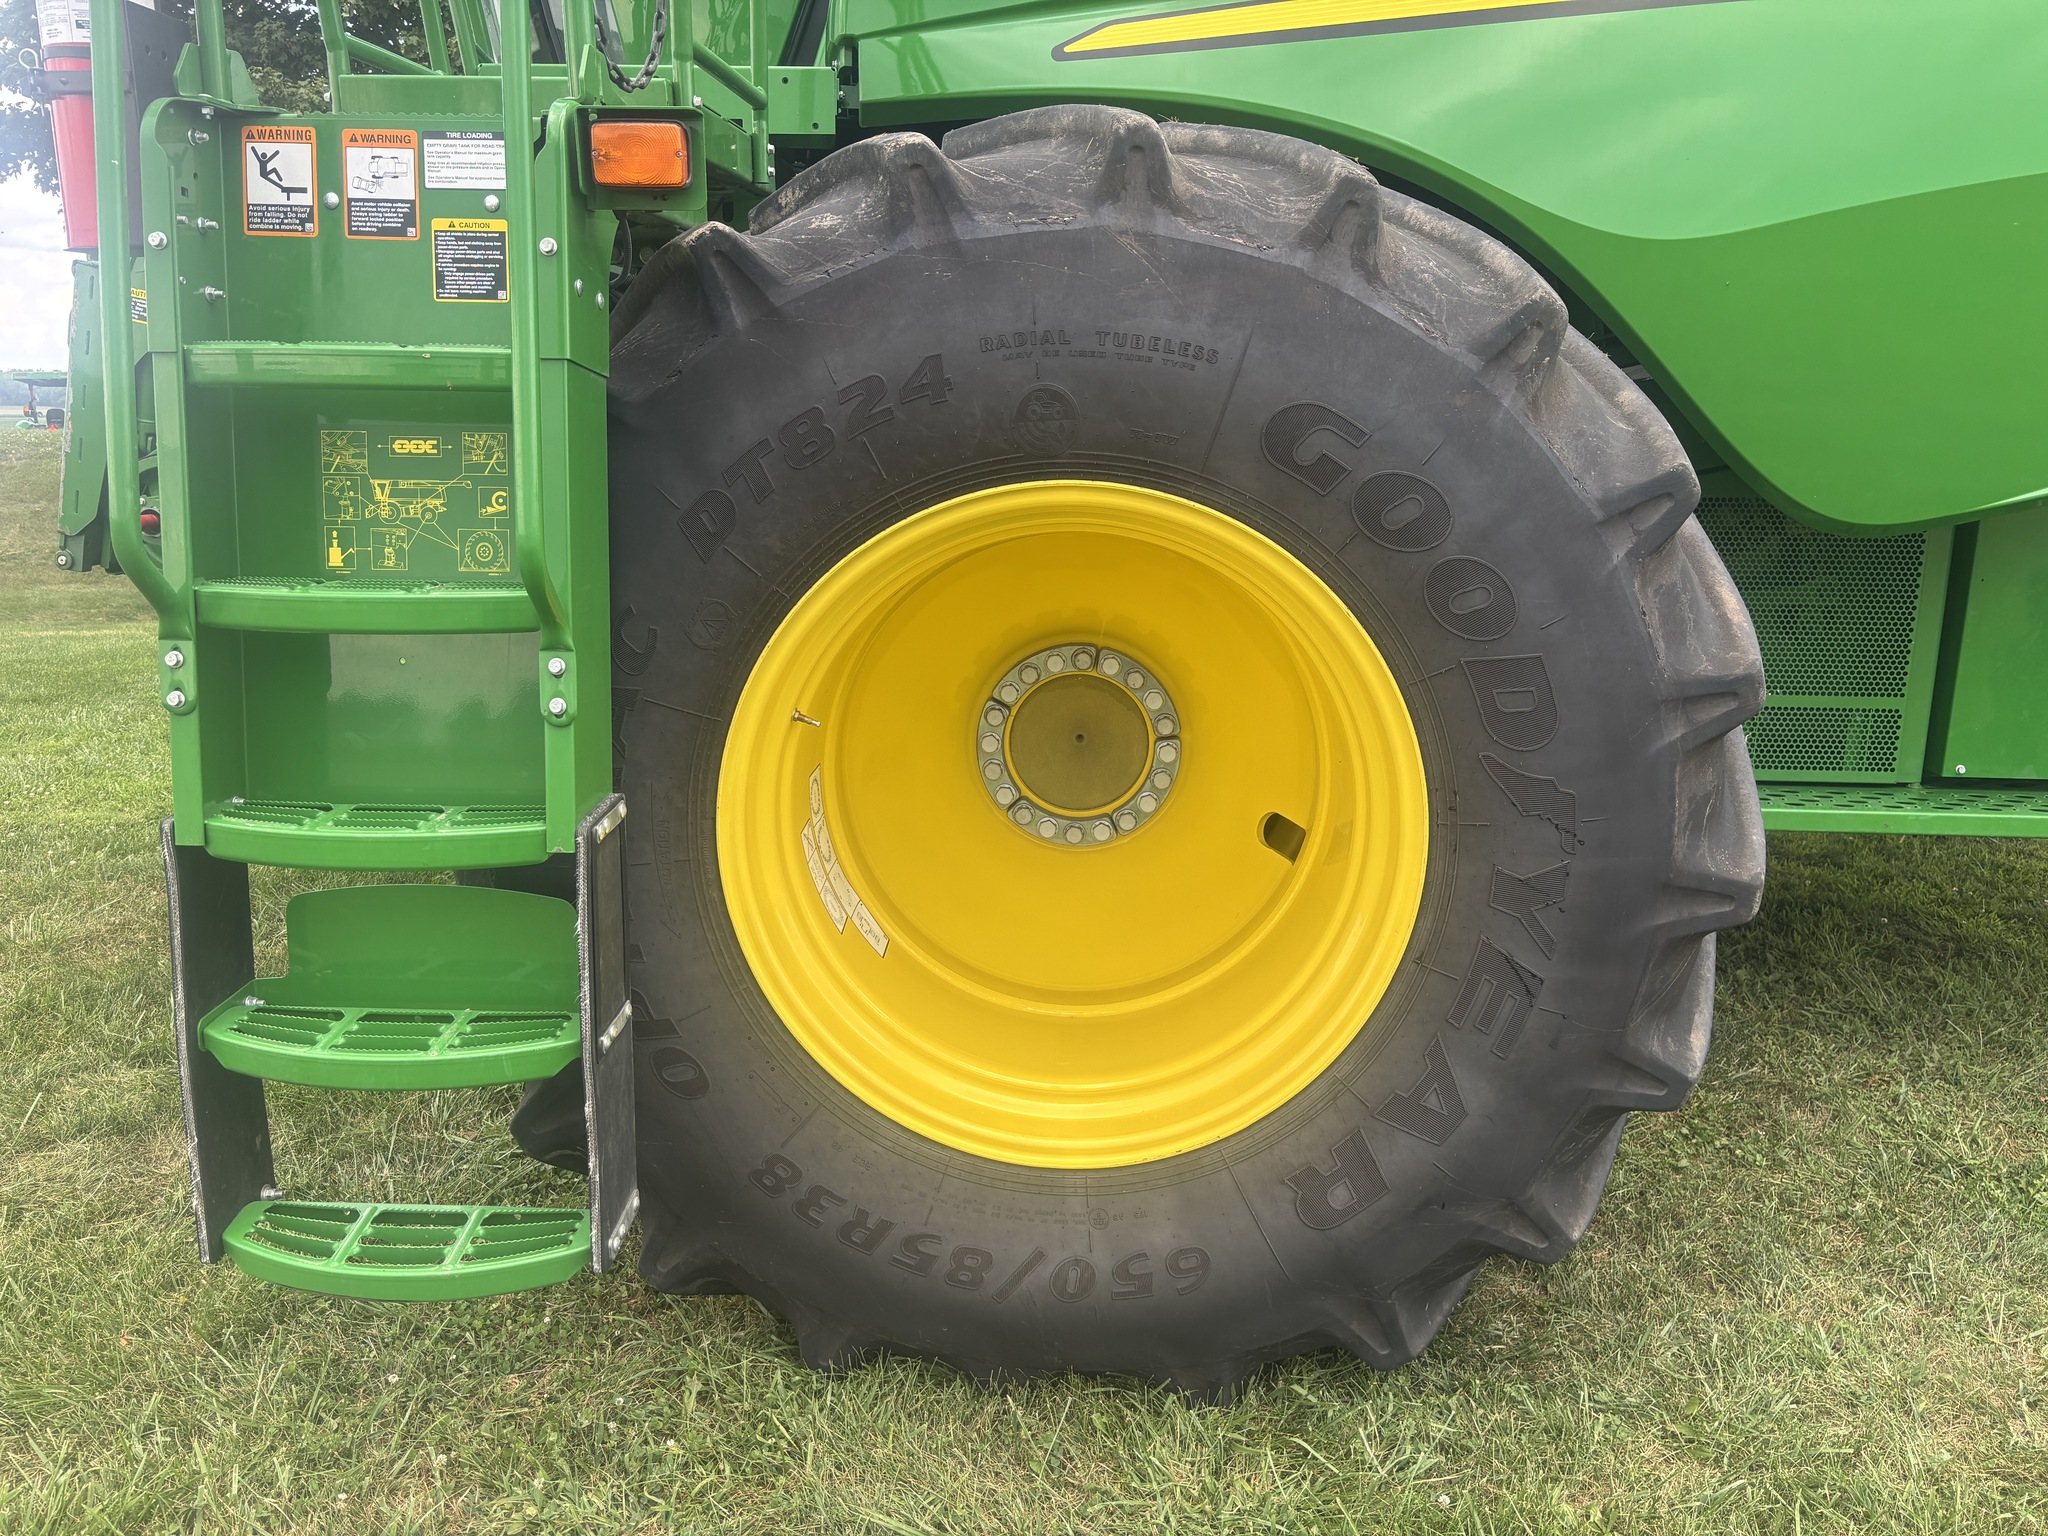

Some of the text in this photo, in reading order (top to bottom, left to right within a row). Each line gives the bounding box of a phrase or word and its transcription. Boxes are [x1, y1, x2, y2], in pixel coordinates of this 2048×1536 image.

[257, 129, 312, 141] WARNING
[360, 134, 412, 144] WARNING
[979, 330, 1220, 364] RADIAL TUBELESS
[1002, 351, 1033, 361] MAY
[1069, 350, 1106, 358] USED
[1116, 352, 1153, 362] TUBE
[1162, 358, 1196, 371] TYPE
[677, 353, 953, 564] DT824
[1261, 401, 1570, 1230] GOODYEAR
[749, 1153, 1212, 1303] 650/85R38
